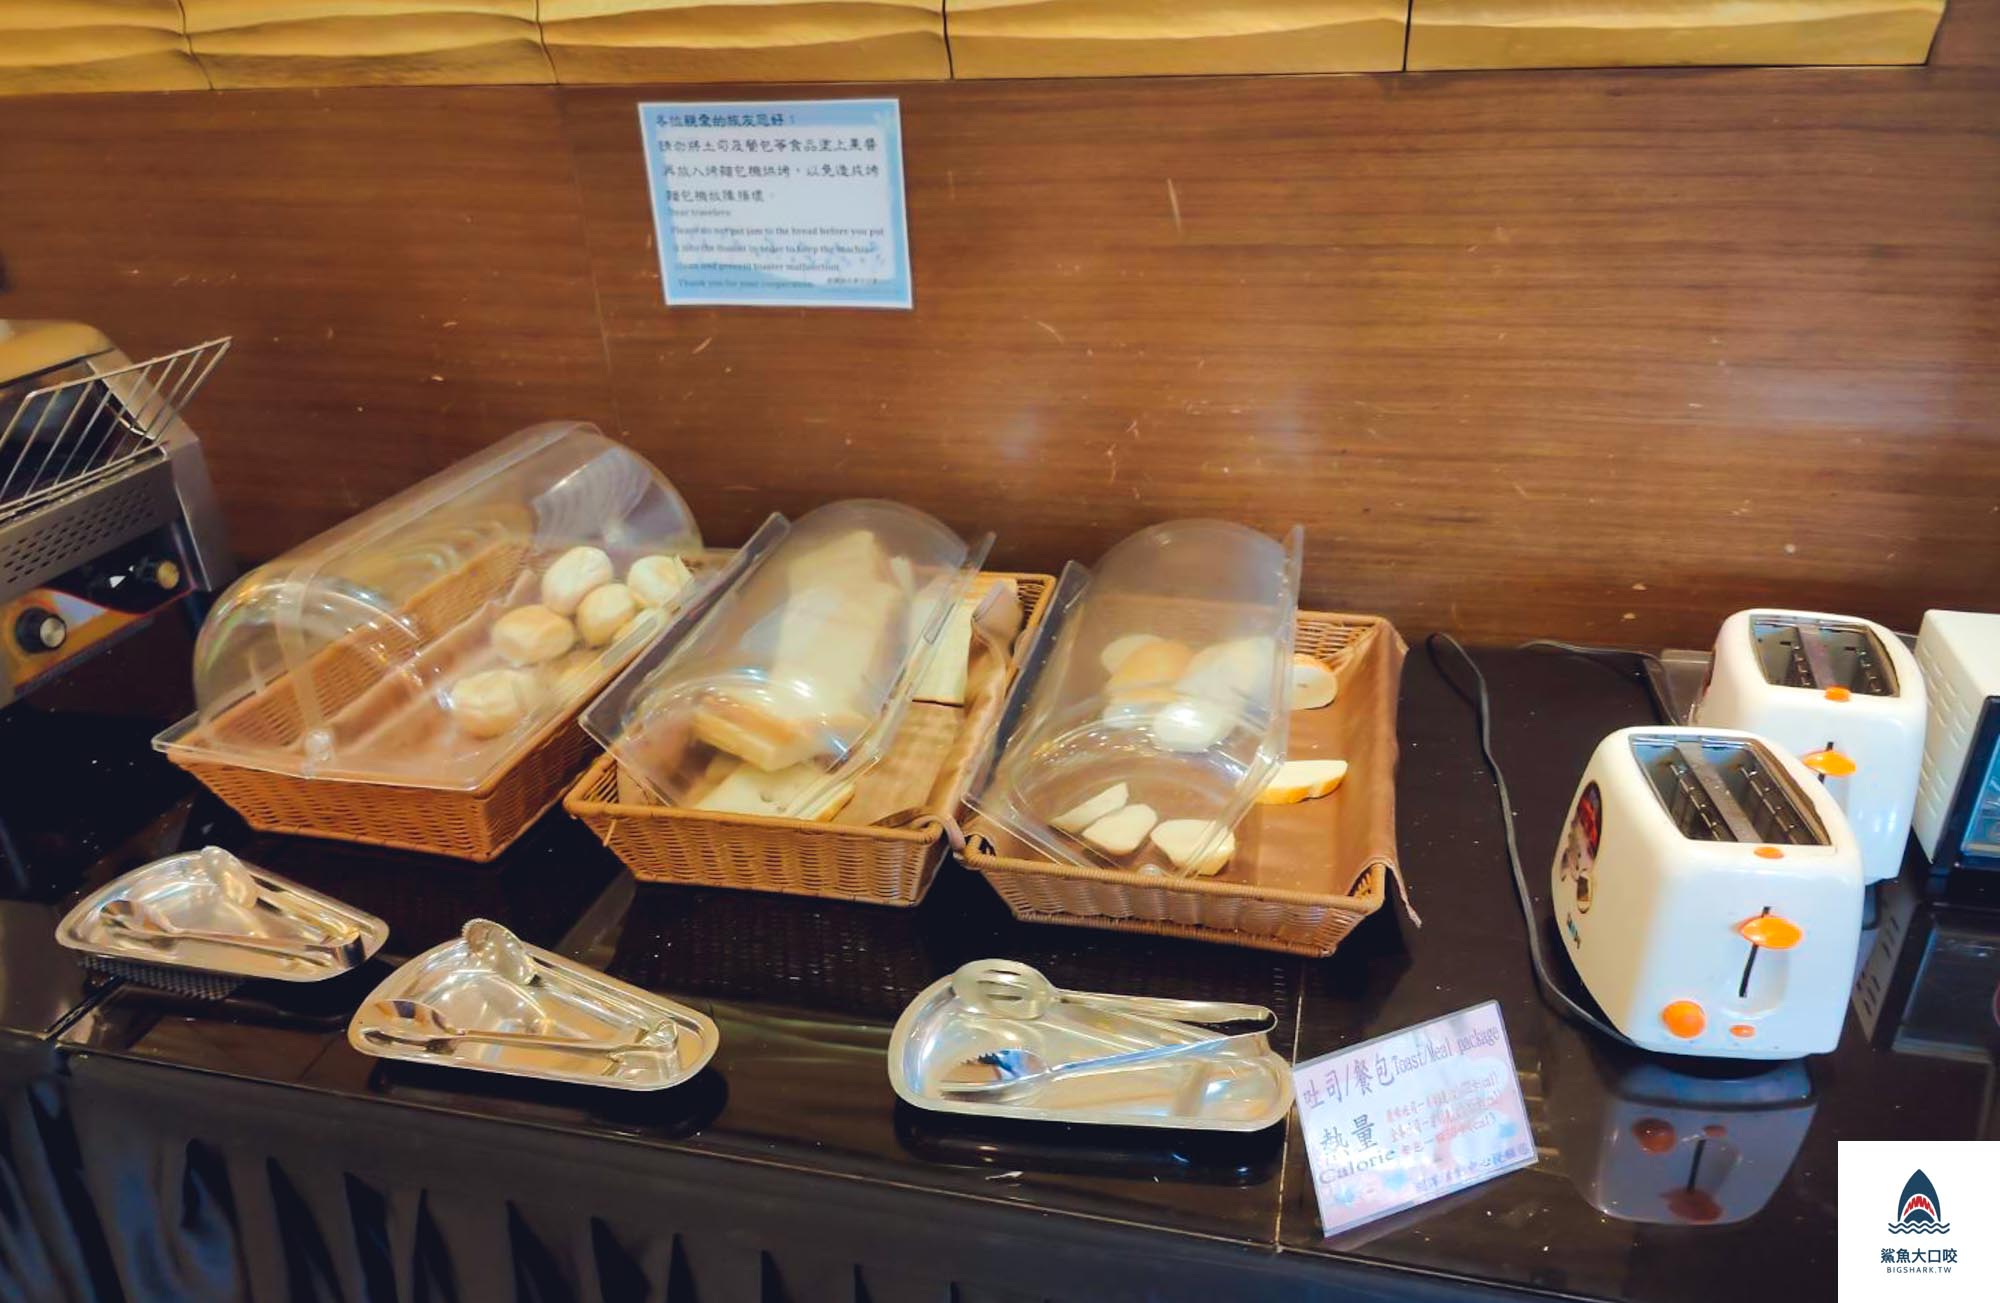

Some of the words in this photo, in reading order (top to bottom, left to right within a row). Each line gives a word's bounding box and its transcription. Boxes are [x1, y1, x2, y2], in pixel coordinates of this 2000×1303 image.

[776, 227, 789, 235] the
[792, 227, 818, 235] bread
[820, 227, 849, 235] before
[1457, 1025, 1500, 1056] package
[1319, 1113, 1378, 1162] 熱量
[1319, 1149, 1396, 1185] Calorie
